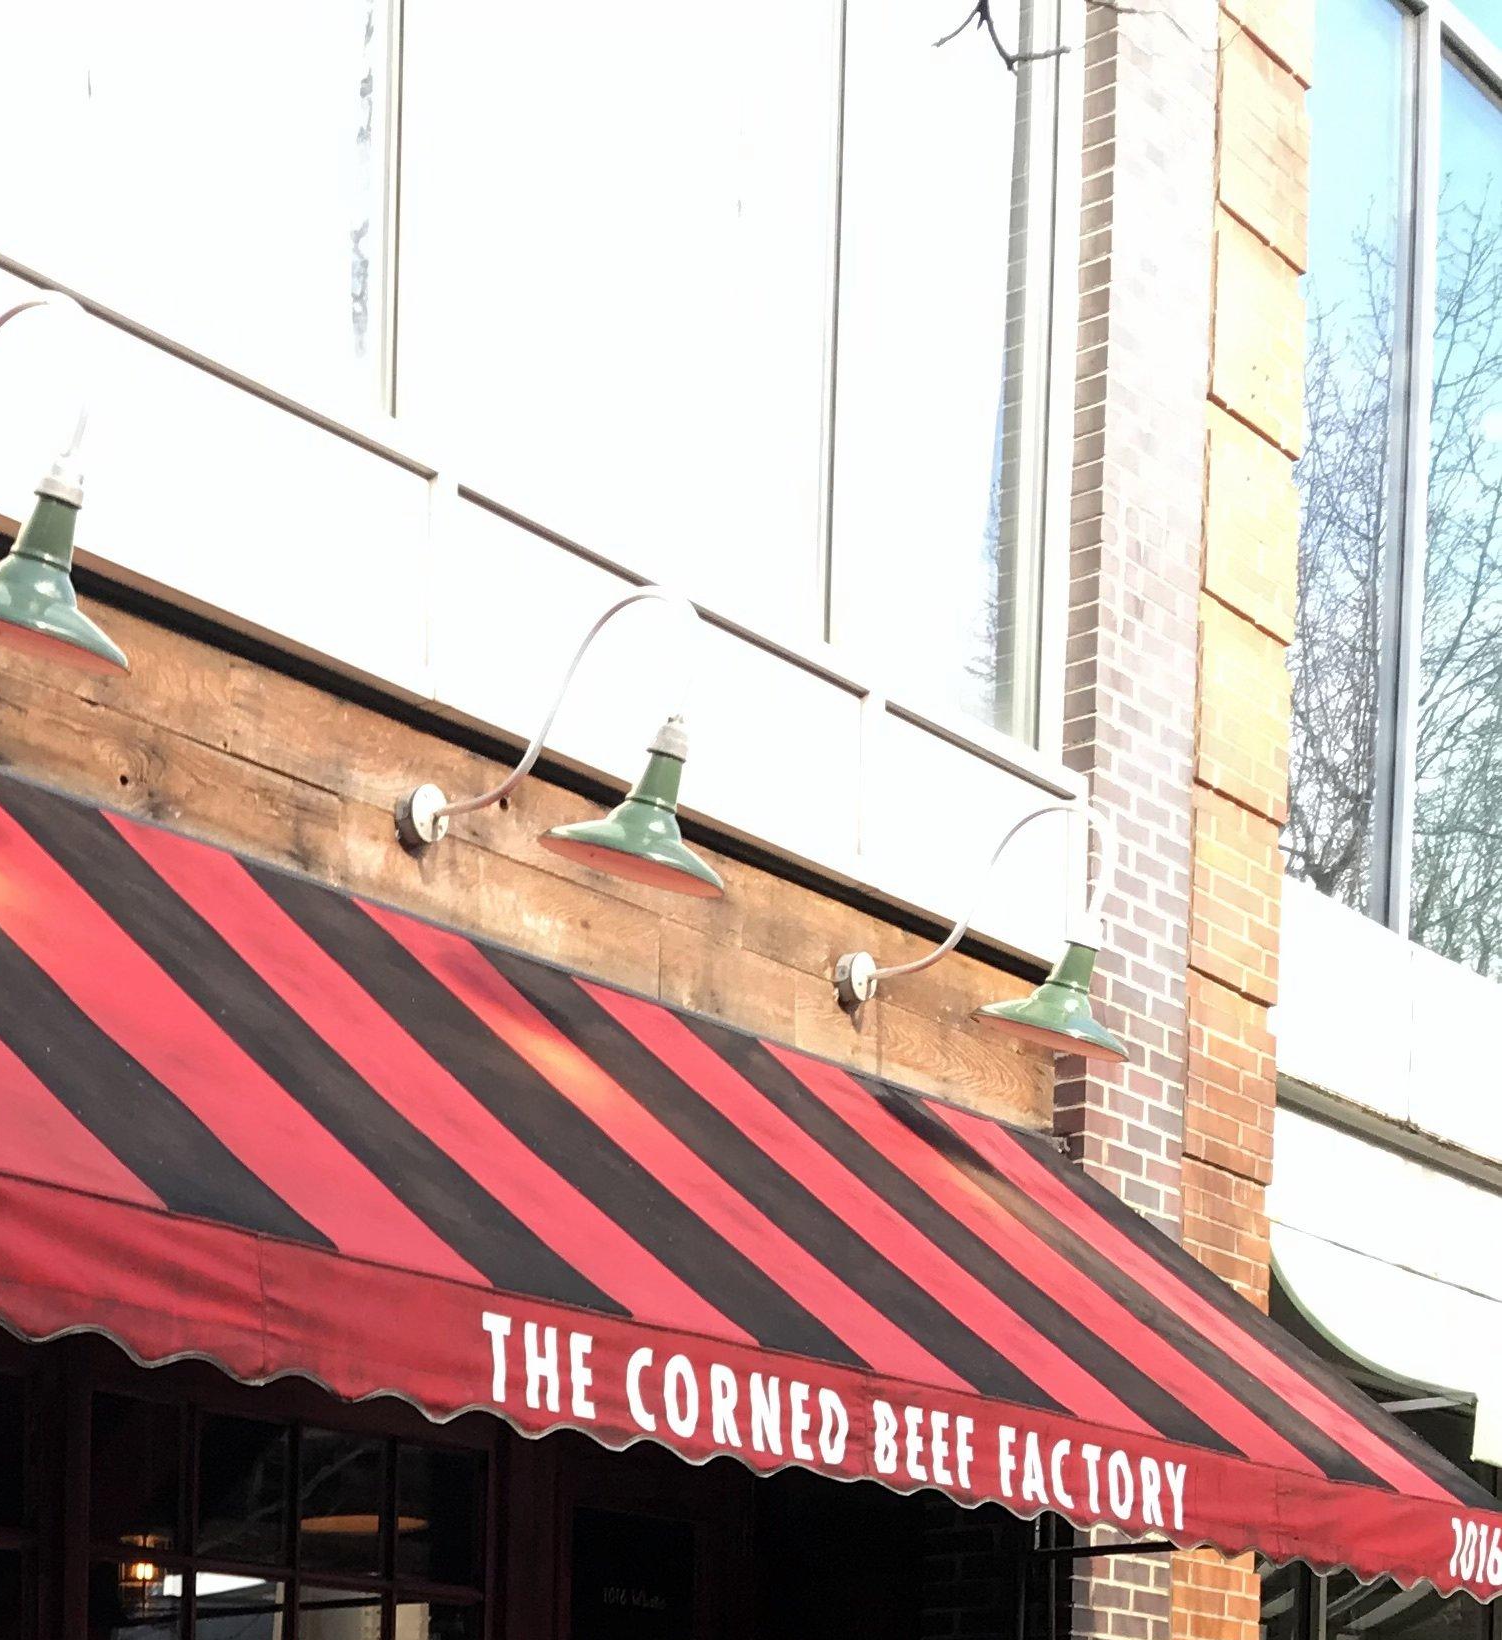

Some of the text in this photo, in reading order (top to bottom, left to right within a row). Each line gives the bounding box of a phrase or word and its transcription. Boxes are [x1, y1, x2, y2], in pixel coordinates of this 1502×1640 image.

[482, 1311, 1188, 1531] THE CORNED BEEF FACTORY
